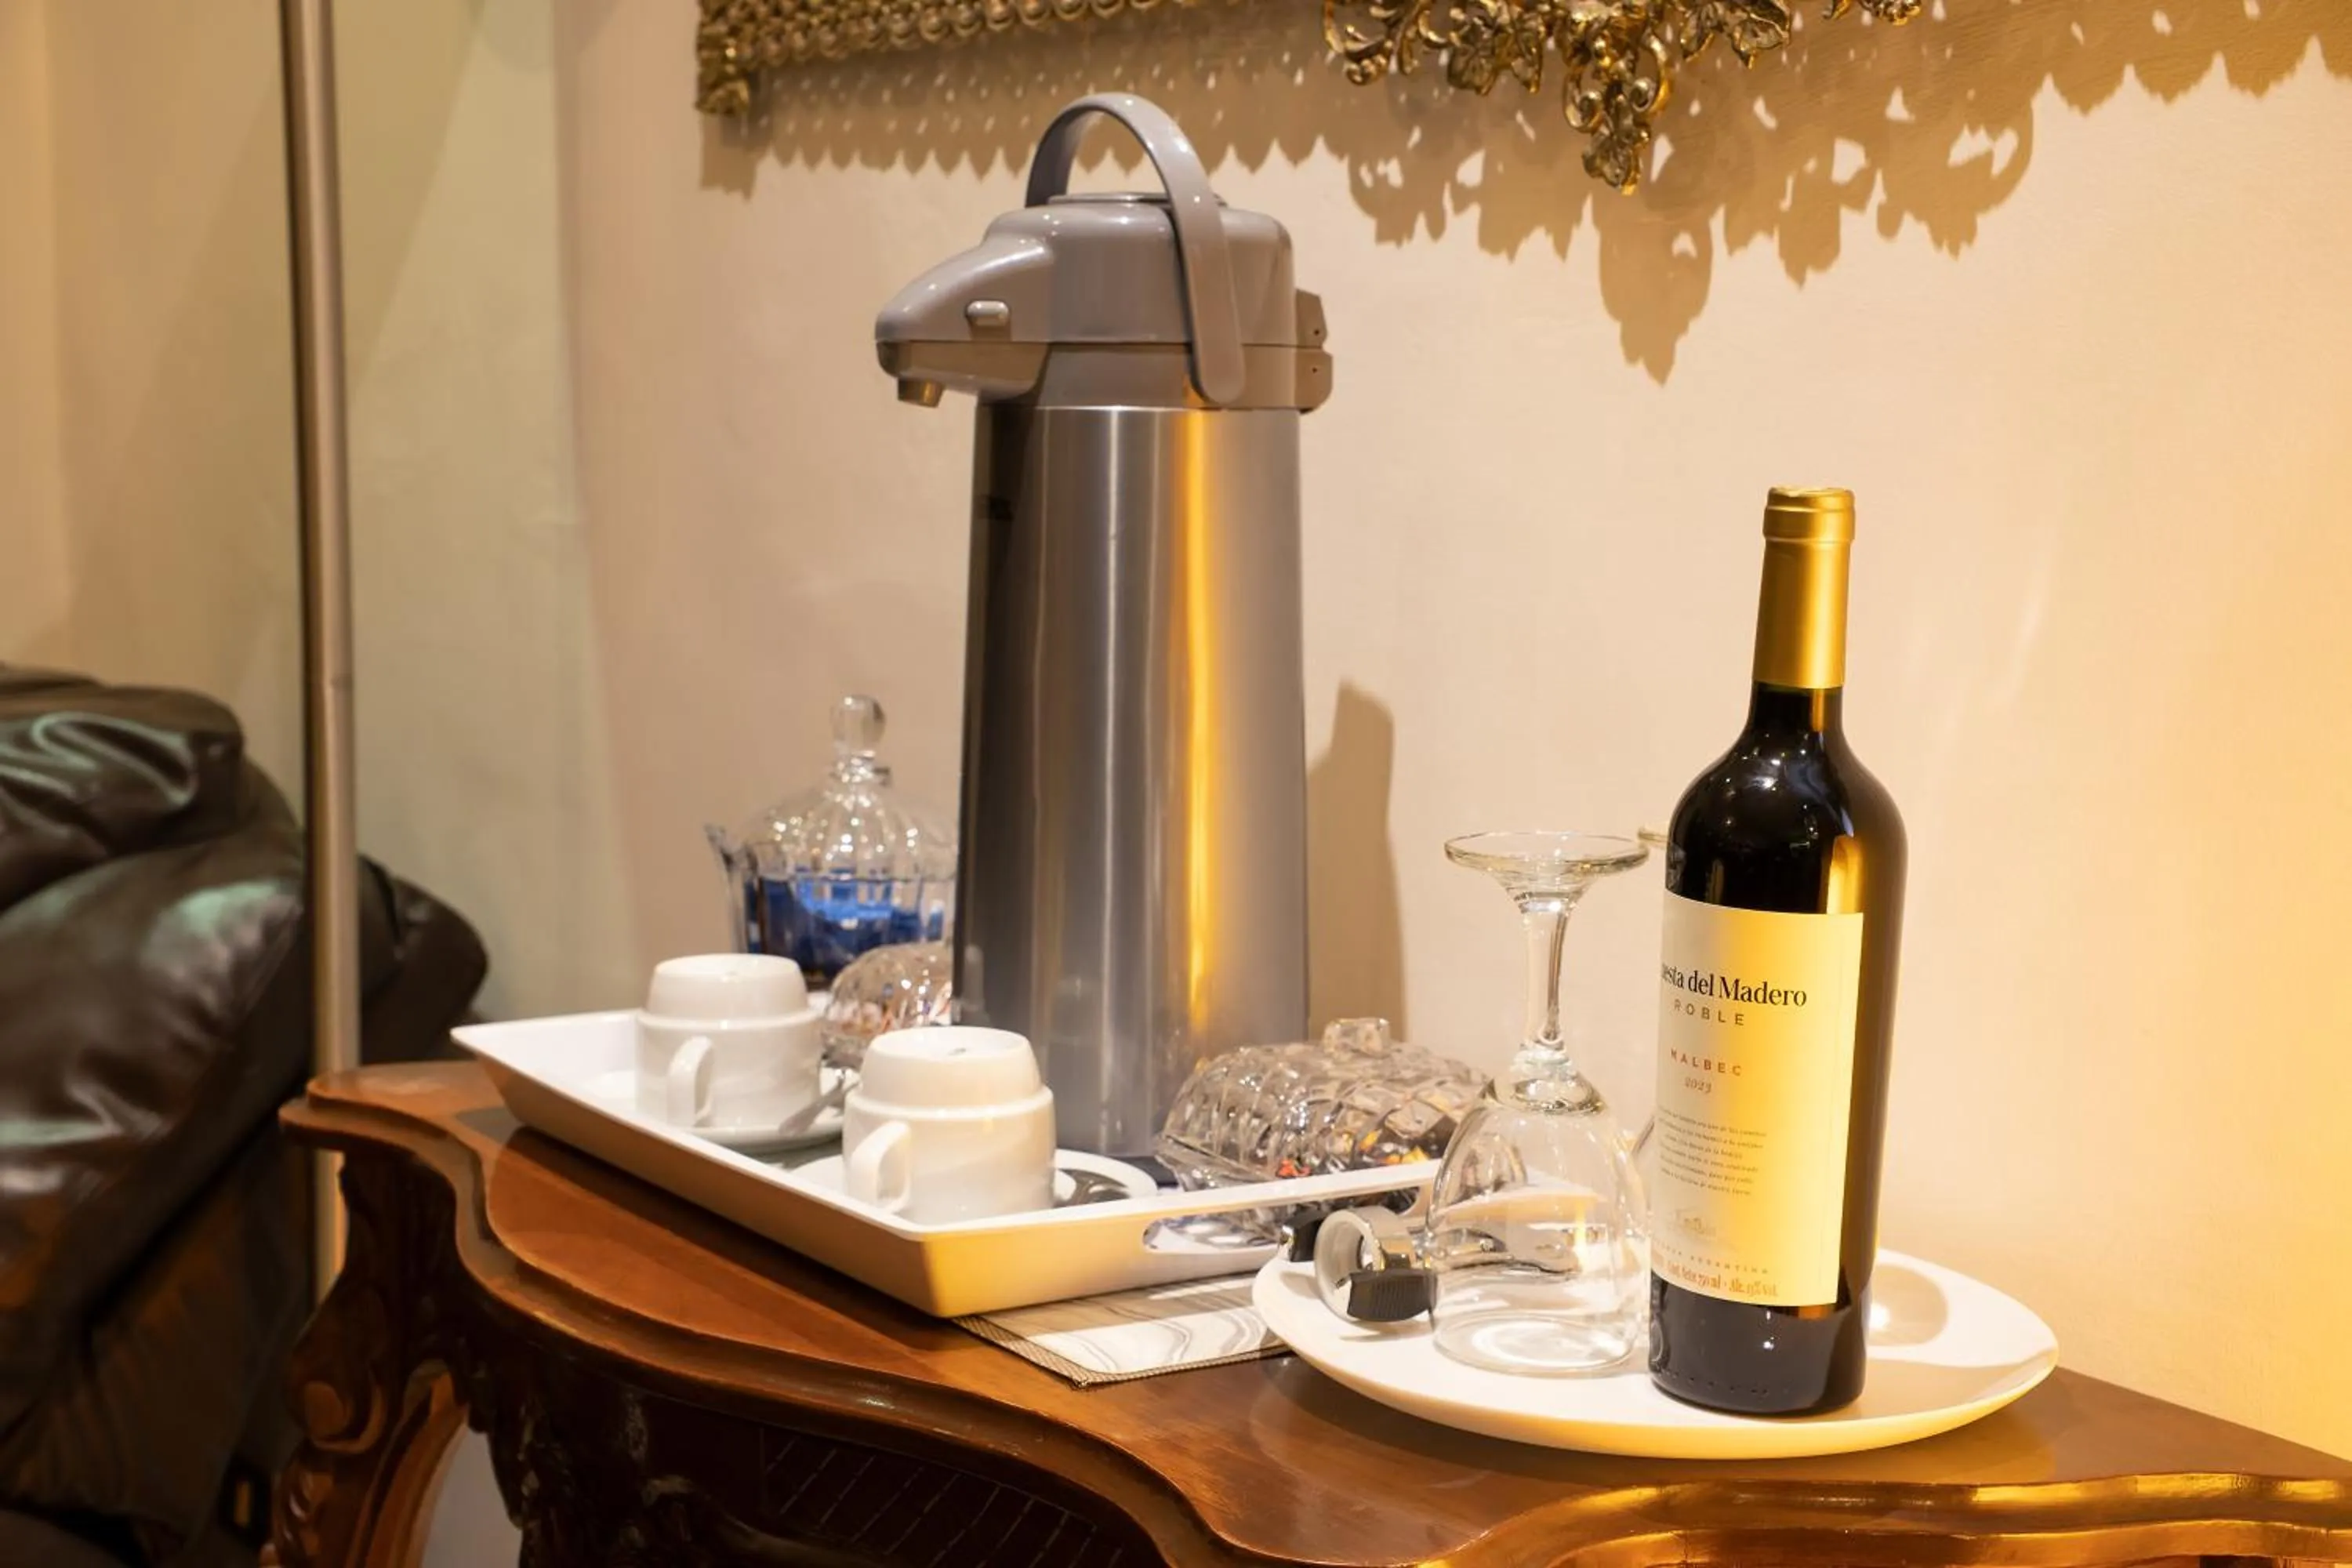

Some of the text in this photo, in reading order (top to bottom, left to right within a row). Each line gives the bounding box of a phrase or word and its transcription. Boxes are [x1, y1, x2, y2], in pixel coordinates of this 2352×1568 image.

[1687, 970, 1715, 997] del
[1719, 975, 1807, 1007] Madero
[1674, 998, 1745, 1026] ROBLE
[1671, 1047, 1743, 1077] MALBEC
